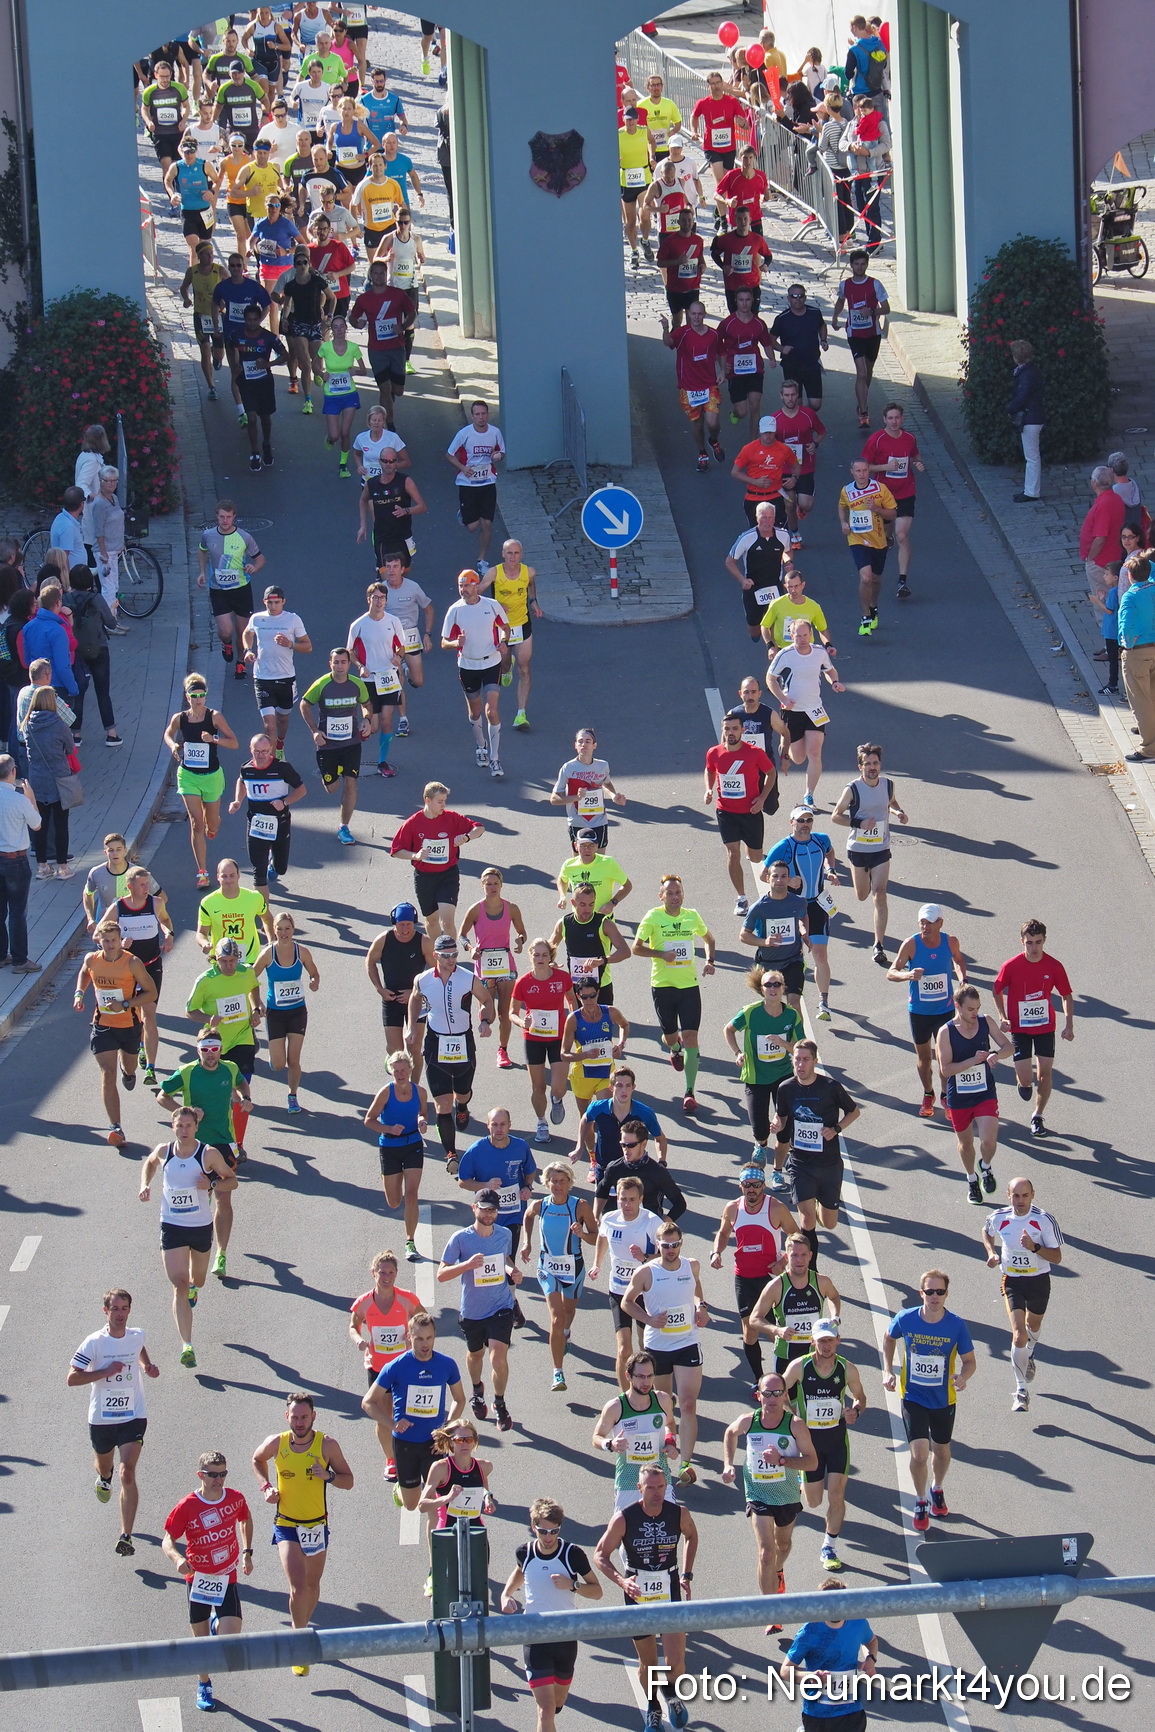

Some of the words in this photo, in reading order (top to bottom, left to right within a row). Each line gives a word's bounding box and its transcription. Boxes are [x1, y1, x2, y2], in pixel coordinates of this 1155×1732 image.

[342, 151, 354, 159] 350
[374, 207, 390, 215] 2246
[737, 359, 753, 367] 2455
[331, 377, 348, 385] 2616
[369, 467, 382, 475] 273
[473, 469, 489, 478] 2147
[852, 516, 869, 524] 2415
[218, 574, 237, 583] 2220
[759, 592, 776, 602] 3061
[380, 676, 394, 685] 304
[325, 697, 357, 707] BOCK
[330, 723, 349, 731] 2535
[187, 749, 206, 759] 3032
[722, 780, 741, 789] 2622
[584, 796, 599, 806] 299
[254, 819, 275, 831] 2318
[863, 827, 879, 836] 216
[426, 845, 446, 855] 2487
[228, 925, 240, 934] M
[770, 924, 791, 935] 3124
[487, 957, 503, 967] 357
[279, 986, 300, 996] 2372
[922, 981, 944, 991] 3008
[224, 1002, 240, 1012] 280
[1023, 1006, 1045, 1017] 2462
[541, 1017, 547, 1026] 3
[445, 1043, 461, 1052] 176
[960, 1072, 982, 1083] 3013
[797, 1128, 819, 1140] 2639
[171, 1194, 193, 1205] 2371
[497, 1192, 517, 1203] 2338
[1011, 1255, 1030, 1266] 213
[484, 1263, 497, 1274] 84
[548, 1261, 571, 1272] 2019
[667, 1312, 685, 1324] 328
[793, 1322, 812, 1332] 243
[380, 1333, 398, 1344] 237
[912, 1337, 944, 1347] STADTLAUF
[914, 1333, 952, 1344] NEUMARKTER
[914, 1363, 939, 1374] 3034
[115, 1374, 123, 1382] G
[105, 1396, 130, 1408] 2267
[414, 1394, 434, 1405] 217
[815, 1407, 834, 1417] 178
[634, 1440, 653, 1452] 244
[465, 1496, 471, 1506] 7
[197, 1578, 223, 1593] 2226
[643, 1581, 663, 1593] 148
